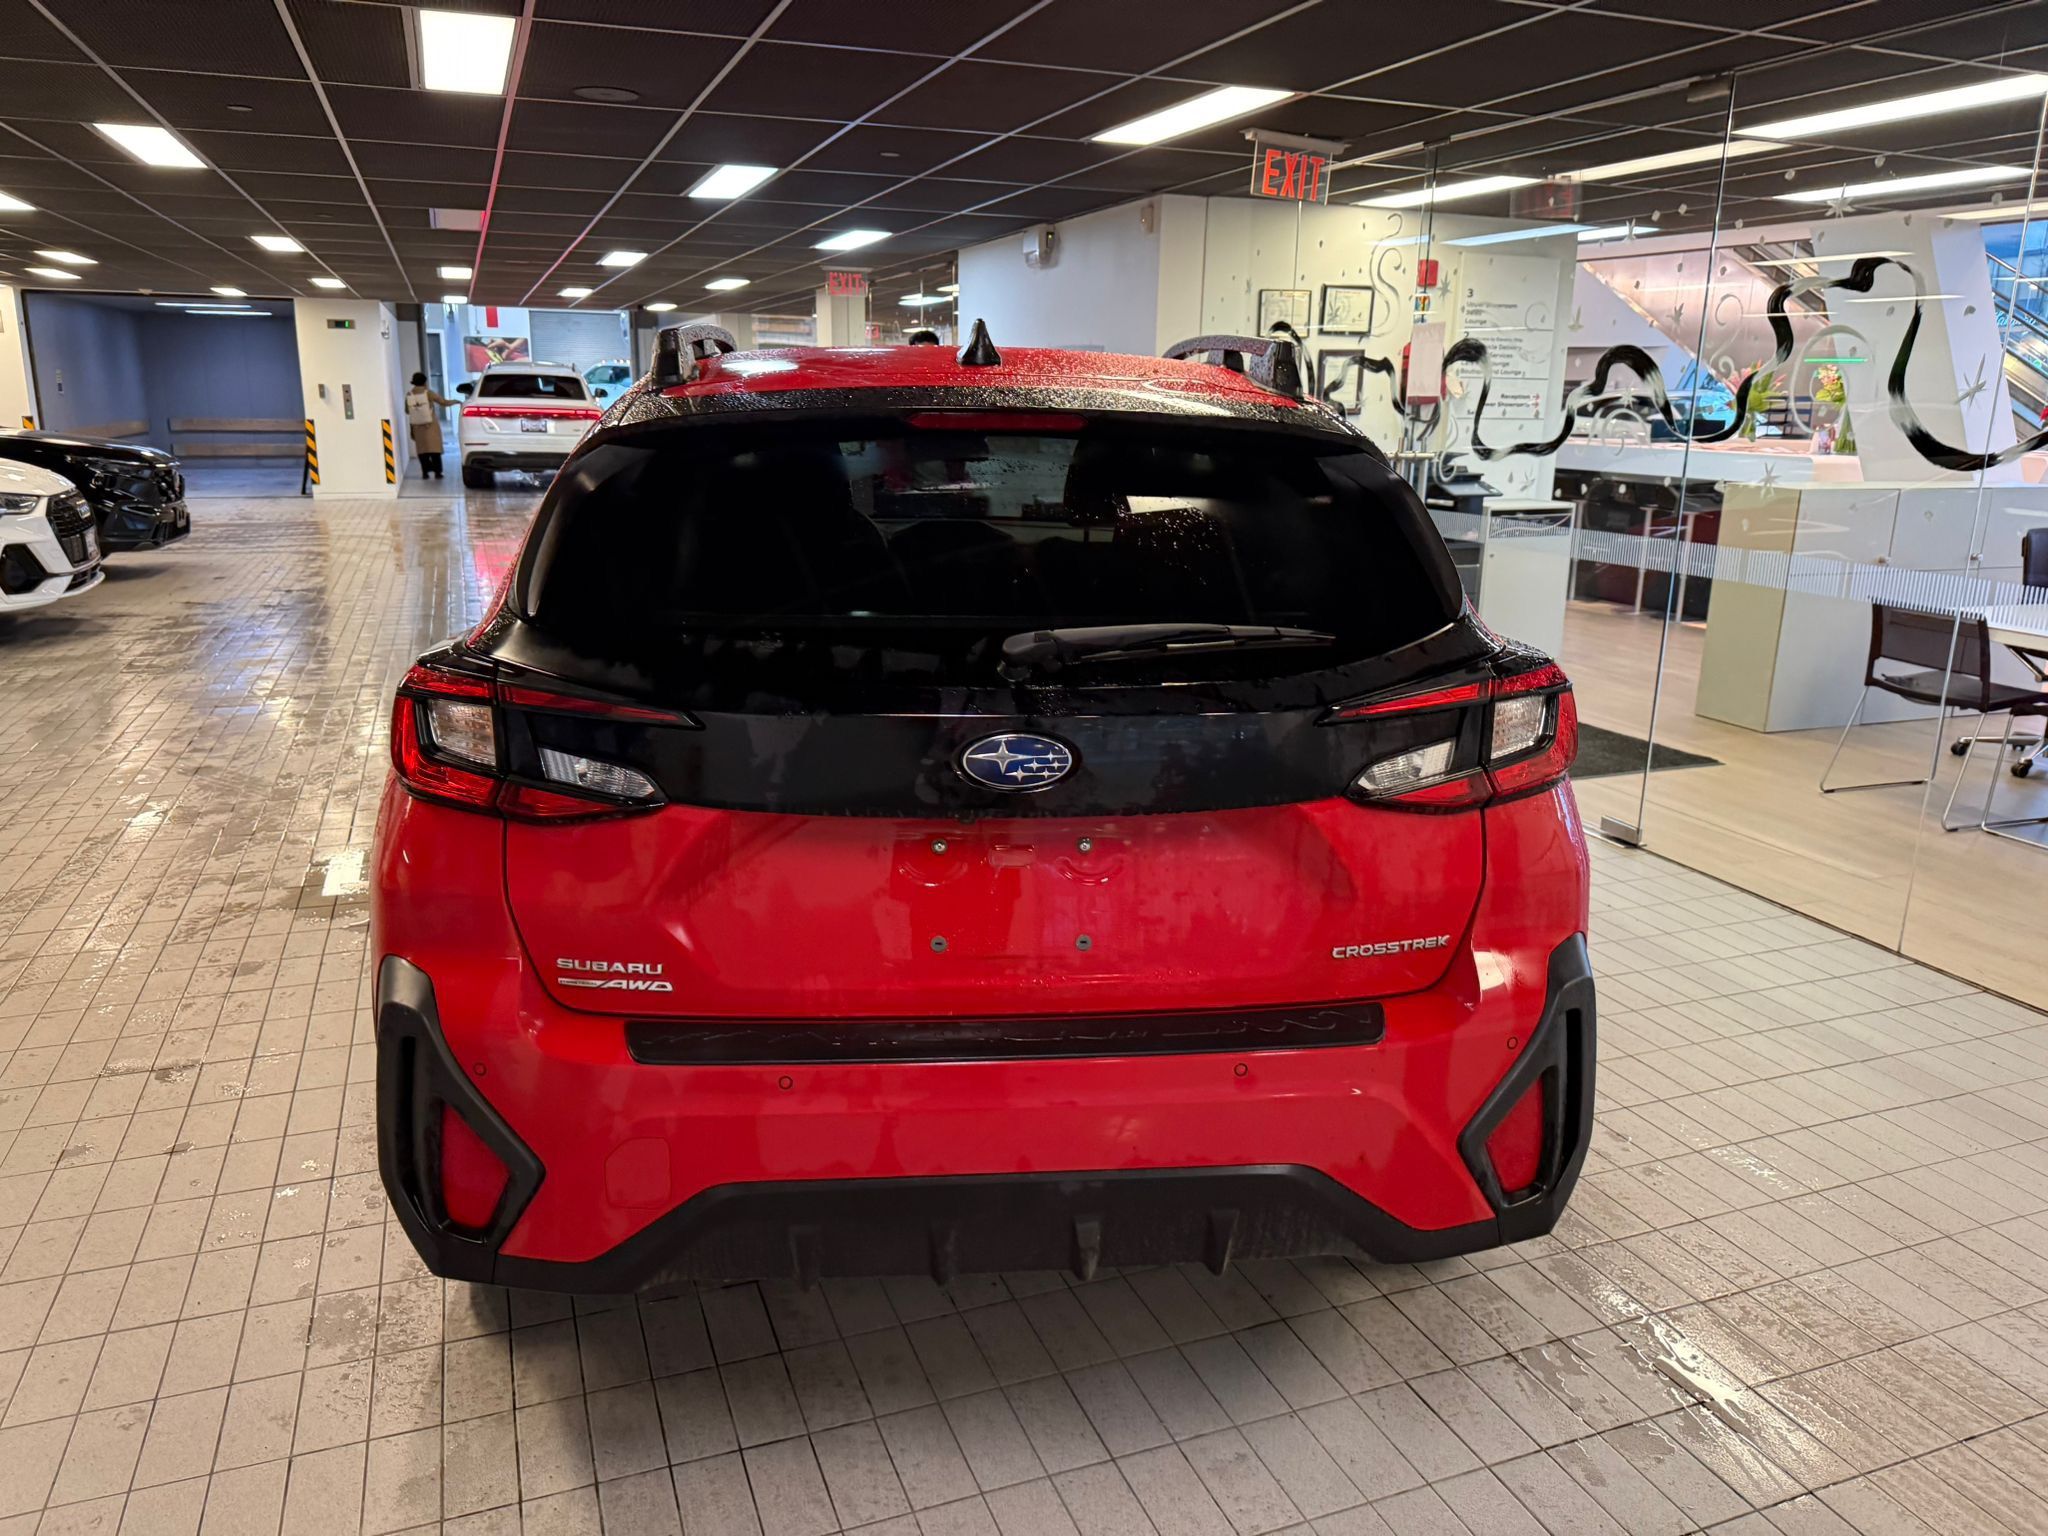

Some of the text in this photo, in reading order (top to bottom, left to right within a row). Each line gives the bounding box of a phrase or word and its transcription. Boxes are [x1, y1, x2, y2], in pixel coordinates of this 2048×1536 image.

[1262, 148, 1326, 202] EXIT
[829, 271, 863, 296] EXIT
[1466, 288, 1474, 298] 3
[1332, 934, 1450, 959] CROSSTREK
[556, 957, 664, 975] SUBARU
[600, 978, 674, 992] AWD
